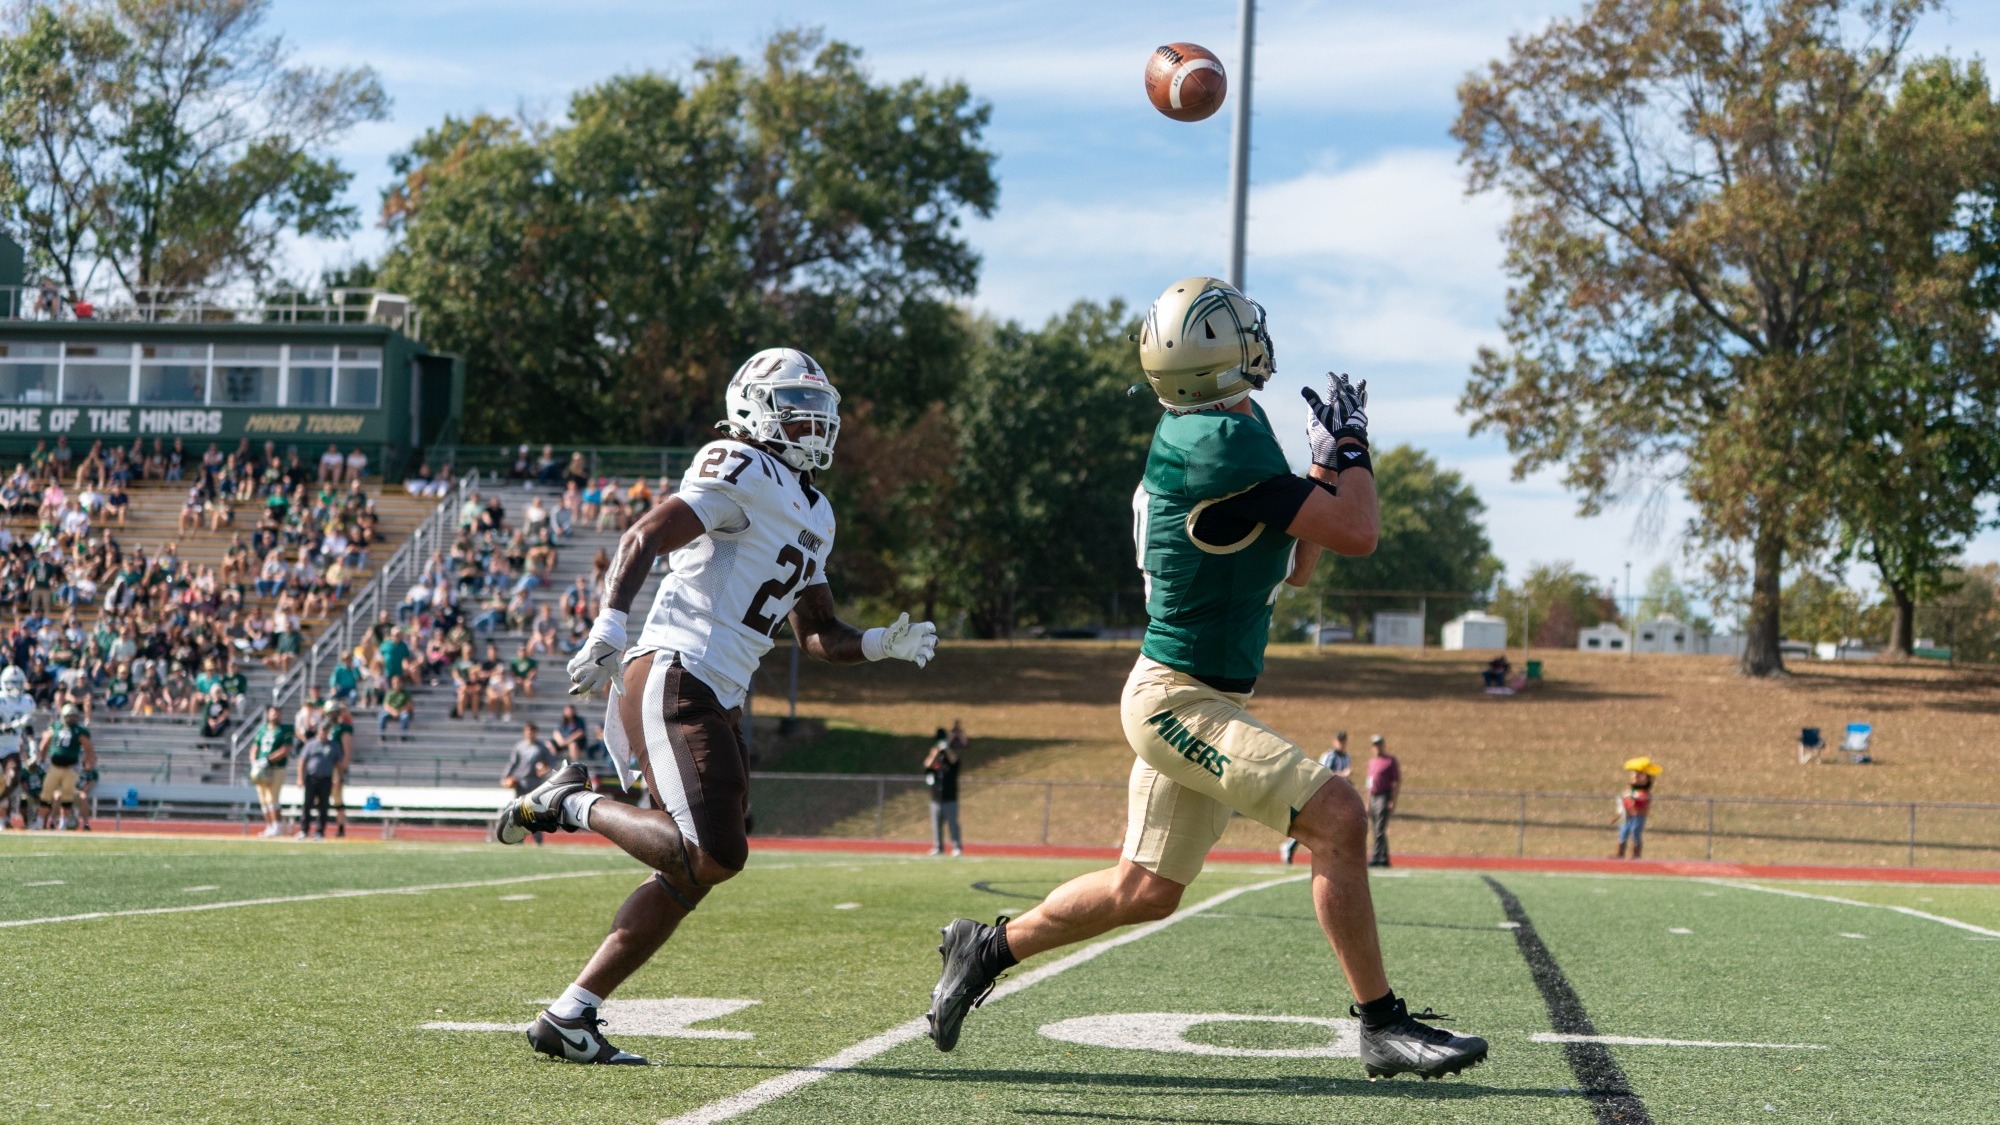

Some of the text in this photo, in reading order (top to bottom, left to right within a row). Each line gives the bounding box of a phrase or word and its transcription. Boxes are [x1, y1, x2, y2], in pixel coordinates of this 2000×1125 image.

[49, 408, 79, 432] OF
[88, 409, 131, 433] THE
[139, 409, 223, 434] MINERS
[244, 413, 365, 434] MINER TOUGH
[699, 448, 753, 485] 27
[798, 529, 824, 556] QUINCY
[1148, 710, 1232, 777] MINERS
